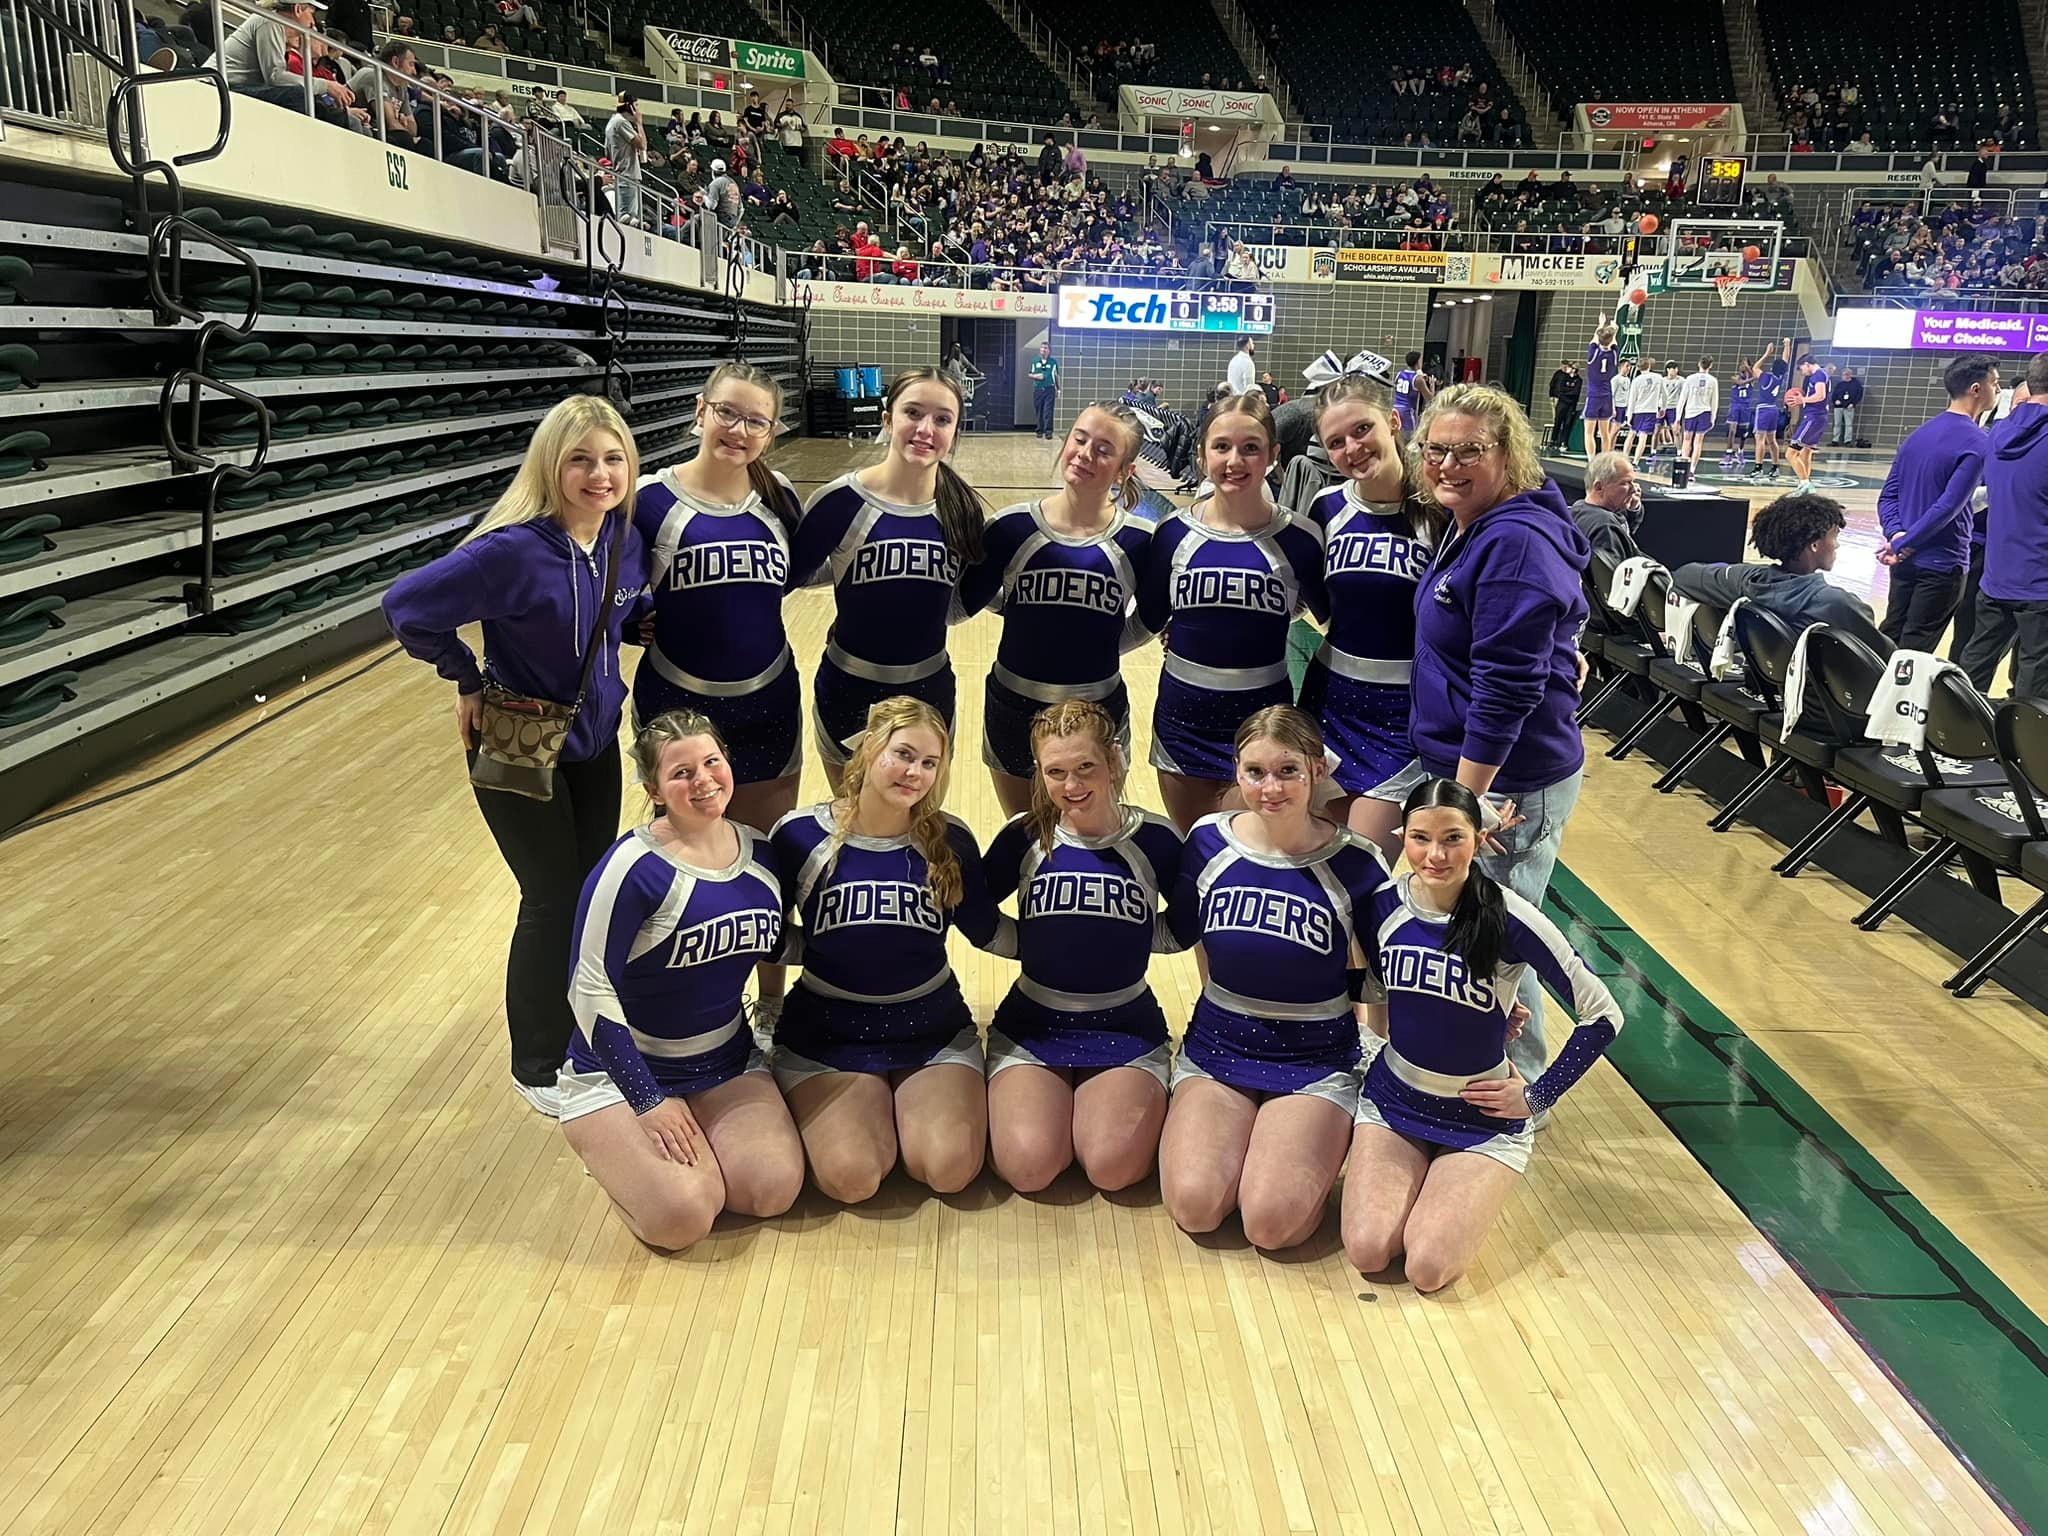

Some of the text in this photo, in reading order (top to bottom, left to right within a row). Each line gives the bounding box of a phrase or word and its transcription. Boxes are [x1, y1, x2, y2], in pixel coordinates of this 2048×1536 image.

[667, 33, 721, 59] Coca-Cola
[746, 48, 795, 70] Sprite
[1138, 96, 1167, 105] SONIC
[1182, 99, 1210, 108] SONIC
[1226, 101, 1254, 110] SONIC
[386, 151, 408, 190] CS2
[1449, 171, 1493, 179] RESERVED
[1340, 252, 1444, 263] THE BOBCAT BATTALION
[1526, 256, 1585, 270] McKEE
[1343, 264, 1438, 274] SCHOLARSHIPS AVAILABLE
[1088, 293, 1167, 324] Tech
[1179, 302, 1190, 318] 0
[1207, 296, 1238, 313] 3:58
[1253, 306, 1263, 321] 0
[1923, 316, 2025, 331] Your Medicaid.
[1920, 331, 2007, 346] Your Choice.
[1600, 359, 1608, 373] 1
[1396, 378, 1410, 394] 20
[671, 541, 787, 591] RIDERS
[852, 539, 960, 585] RIDERS
[1325, 533, 1433, 581] RIDERS
[1014, 568, 1123, 616] RIDERS
[1175, 568, 1288, 616] RIDERS
[1026, 871, 1148, 925] RIDERS
[813, 880, 944, 936] RIDERS
[1203, 886, 1334, 955] RIDERS
[665, 909, 780, 968] RIDERS
[1380, 945, 1495, 1013] RIDERS
